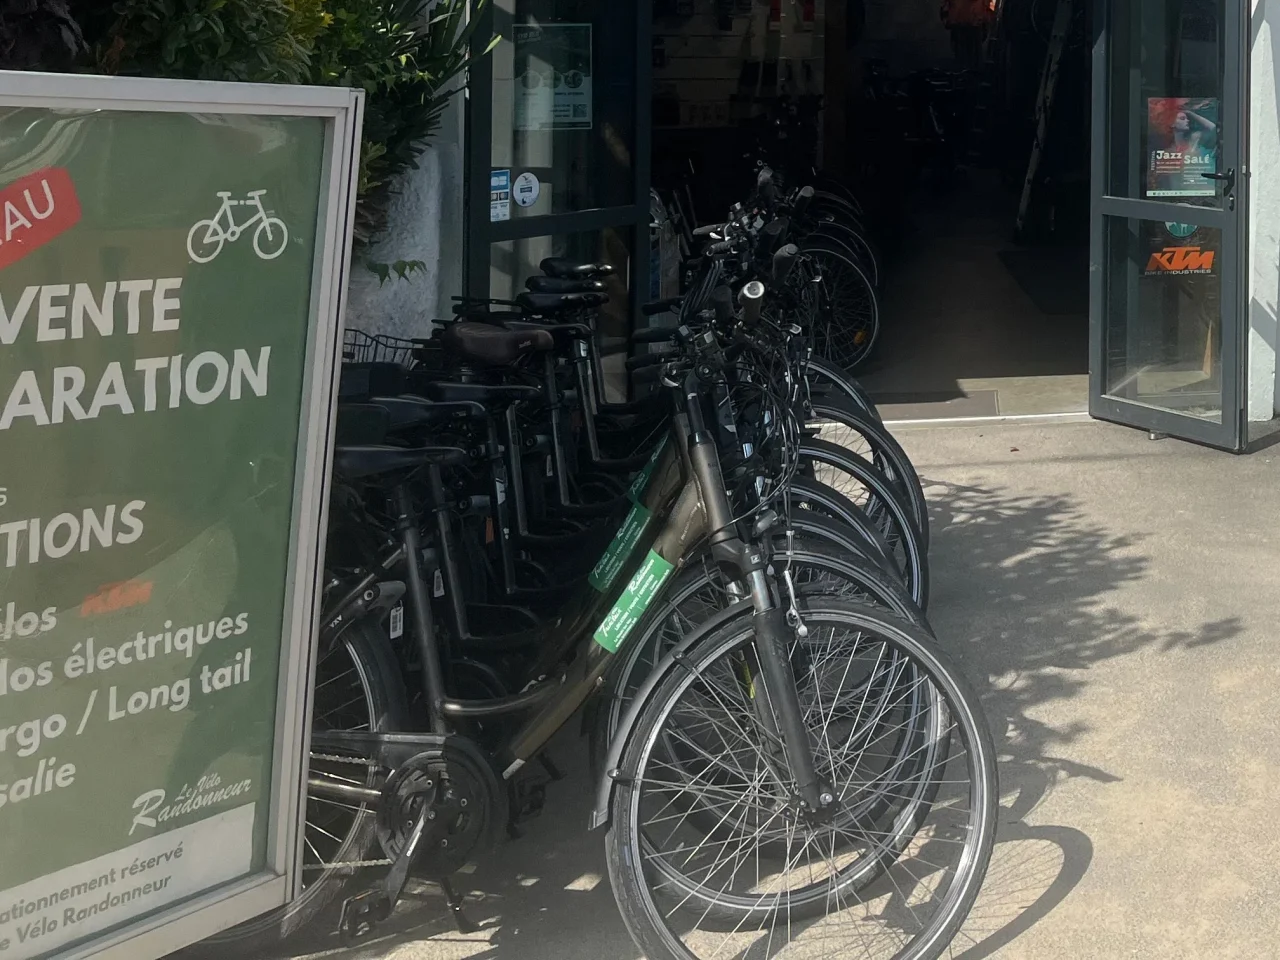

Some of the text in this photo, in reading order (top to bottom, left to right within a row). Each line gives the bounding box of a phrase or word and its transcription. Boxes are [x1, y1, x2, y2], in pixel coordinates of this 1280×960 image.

[1156, 150, 1182, 160] Jazz
[0, 179, 55, 246] AU
[1146, 247, 1214, 271] KTM
[0, 278, 183, 345] VENTE
[0, 346, 271, 430] ARATION
[0, 500, 146, 568] TIONS
[64, 612, 249, 679] électriques
[0, 648, 251, 757] rgo / Long tail
[129, 778, 252, 836] Randonneur
[175, 772, 223, 802] Le Vélo
[0, 841, 184, 925] ationnement réservé
[16, 913, 58, 944] Vélo
[62, 874, 172, 928] Randonneur
